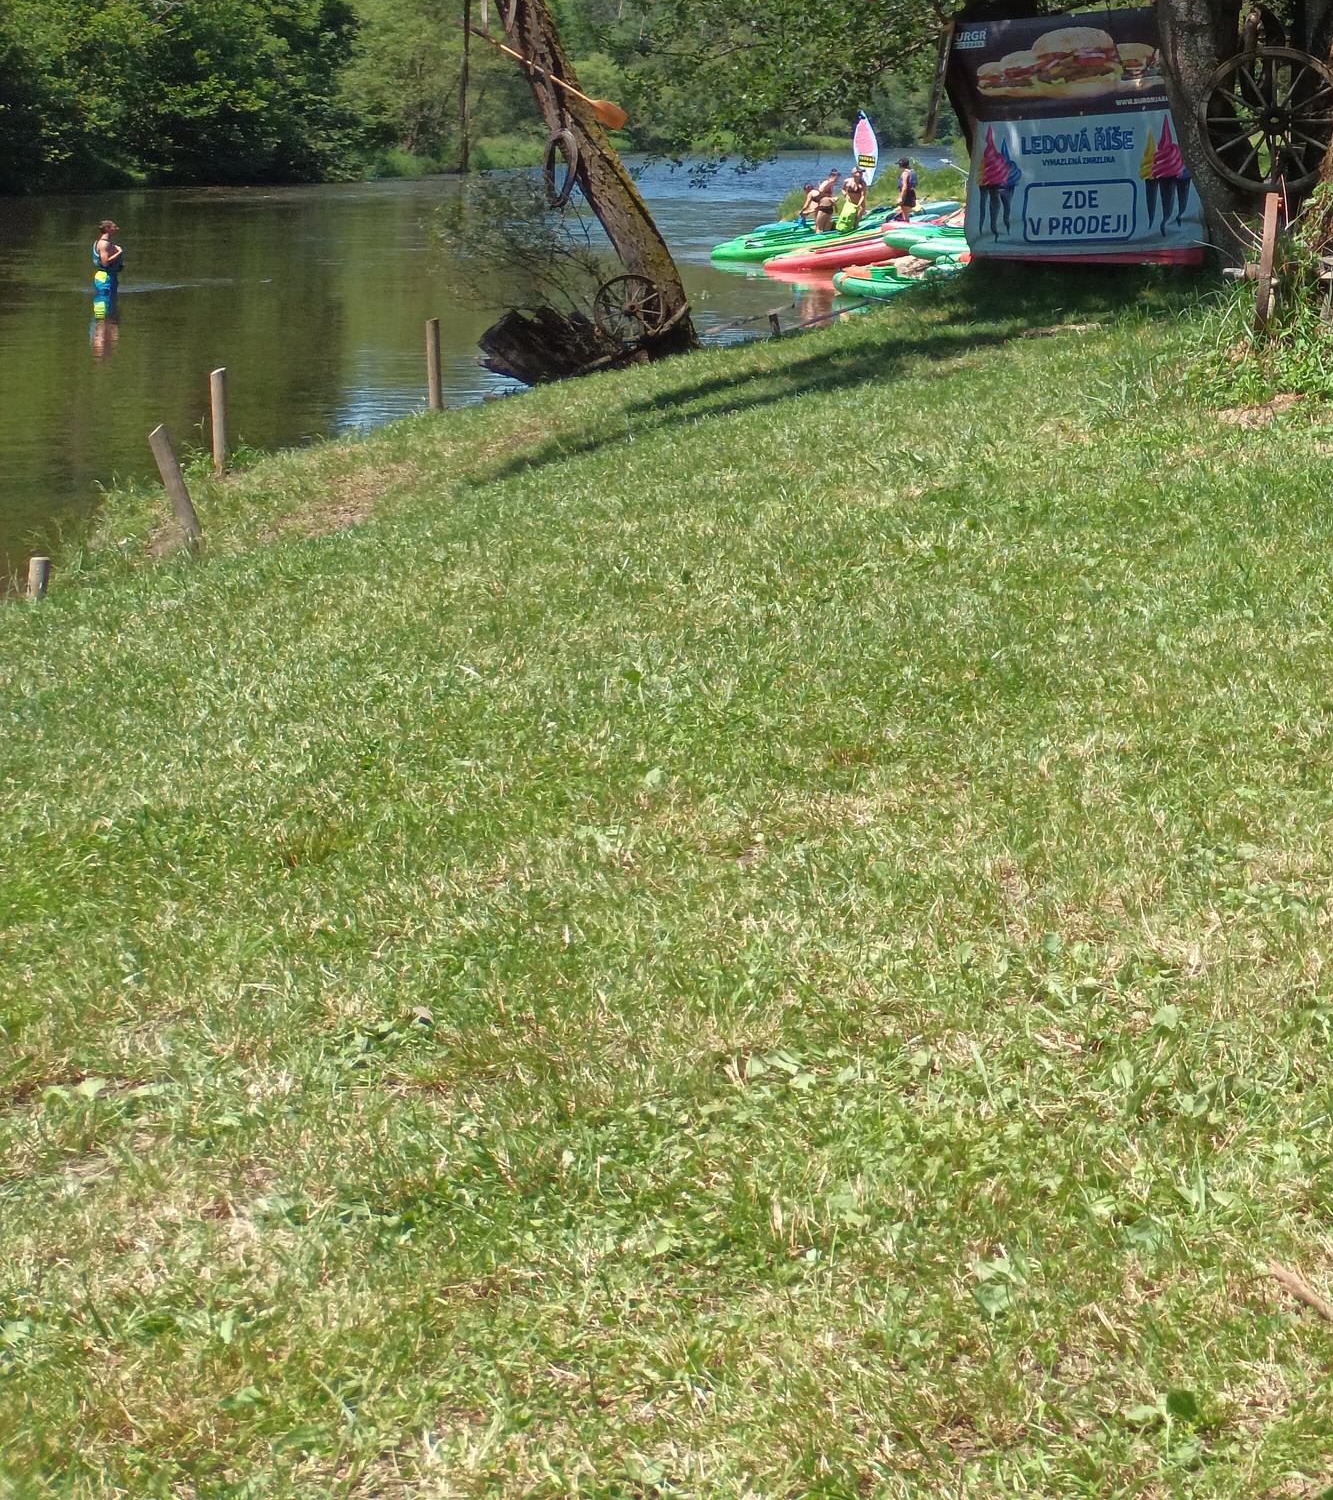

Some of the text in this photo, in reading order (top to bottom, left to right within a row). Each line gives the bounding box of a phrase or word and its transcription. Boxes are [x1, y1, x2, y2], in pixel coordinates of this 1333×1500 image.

[956, 29, 988, 42] URGR
[1021, 126, 1134, 155] LEDOVÁ ŘÍŠE
[1062, 189, 1099, 209] ZDE
[1028, 214, 1128, 236] V PRODEJI
